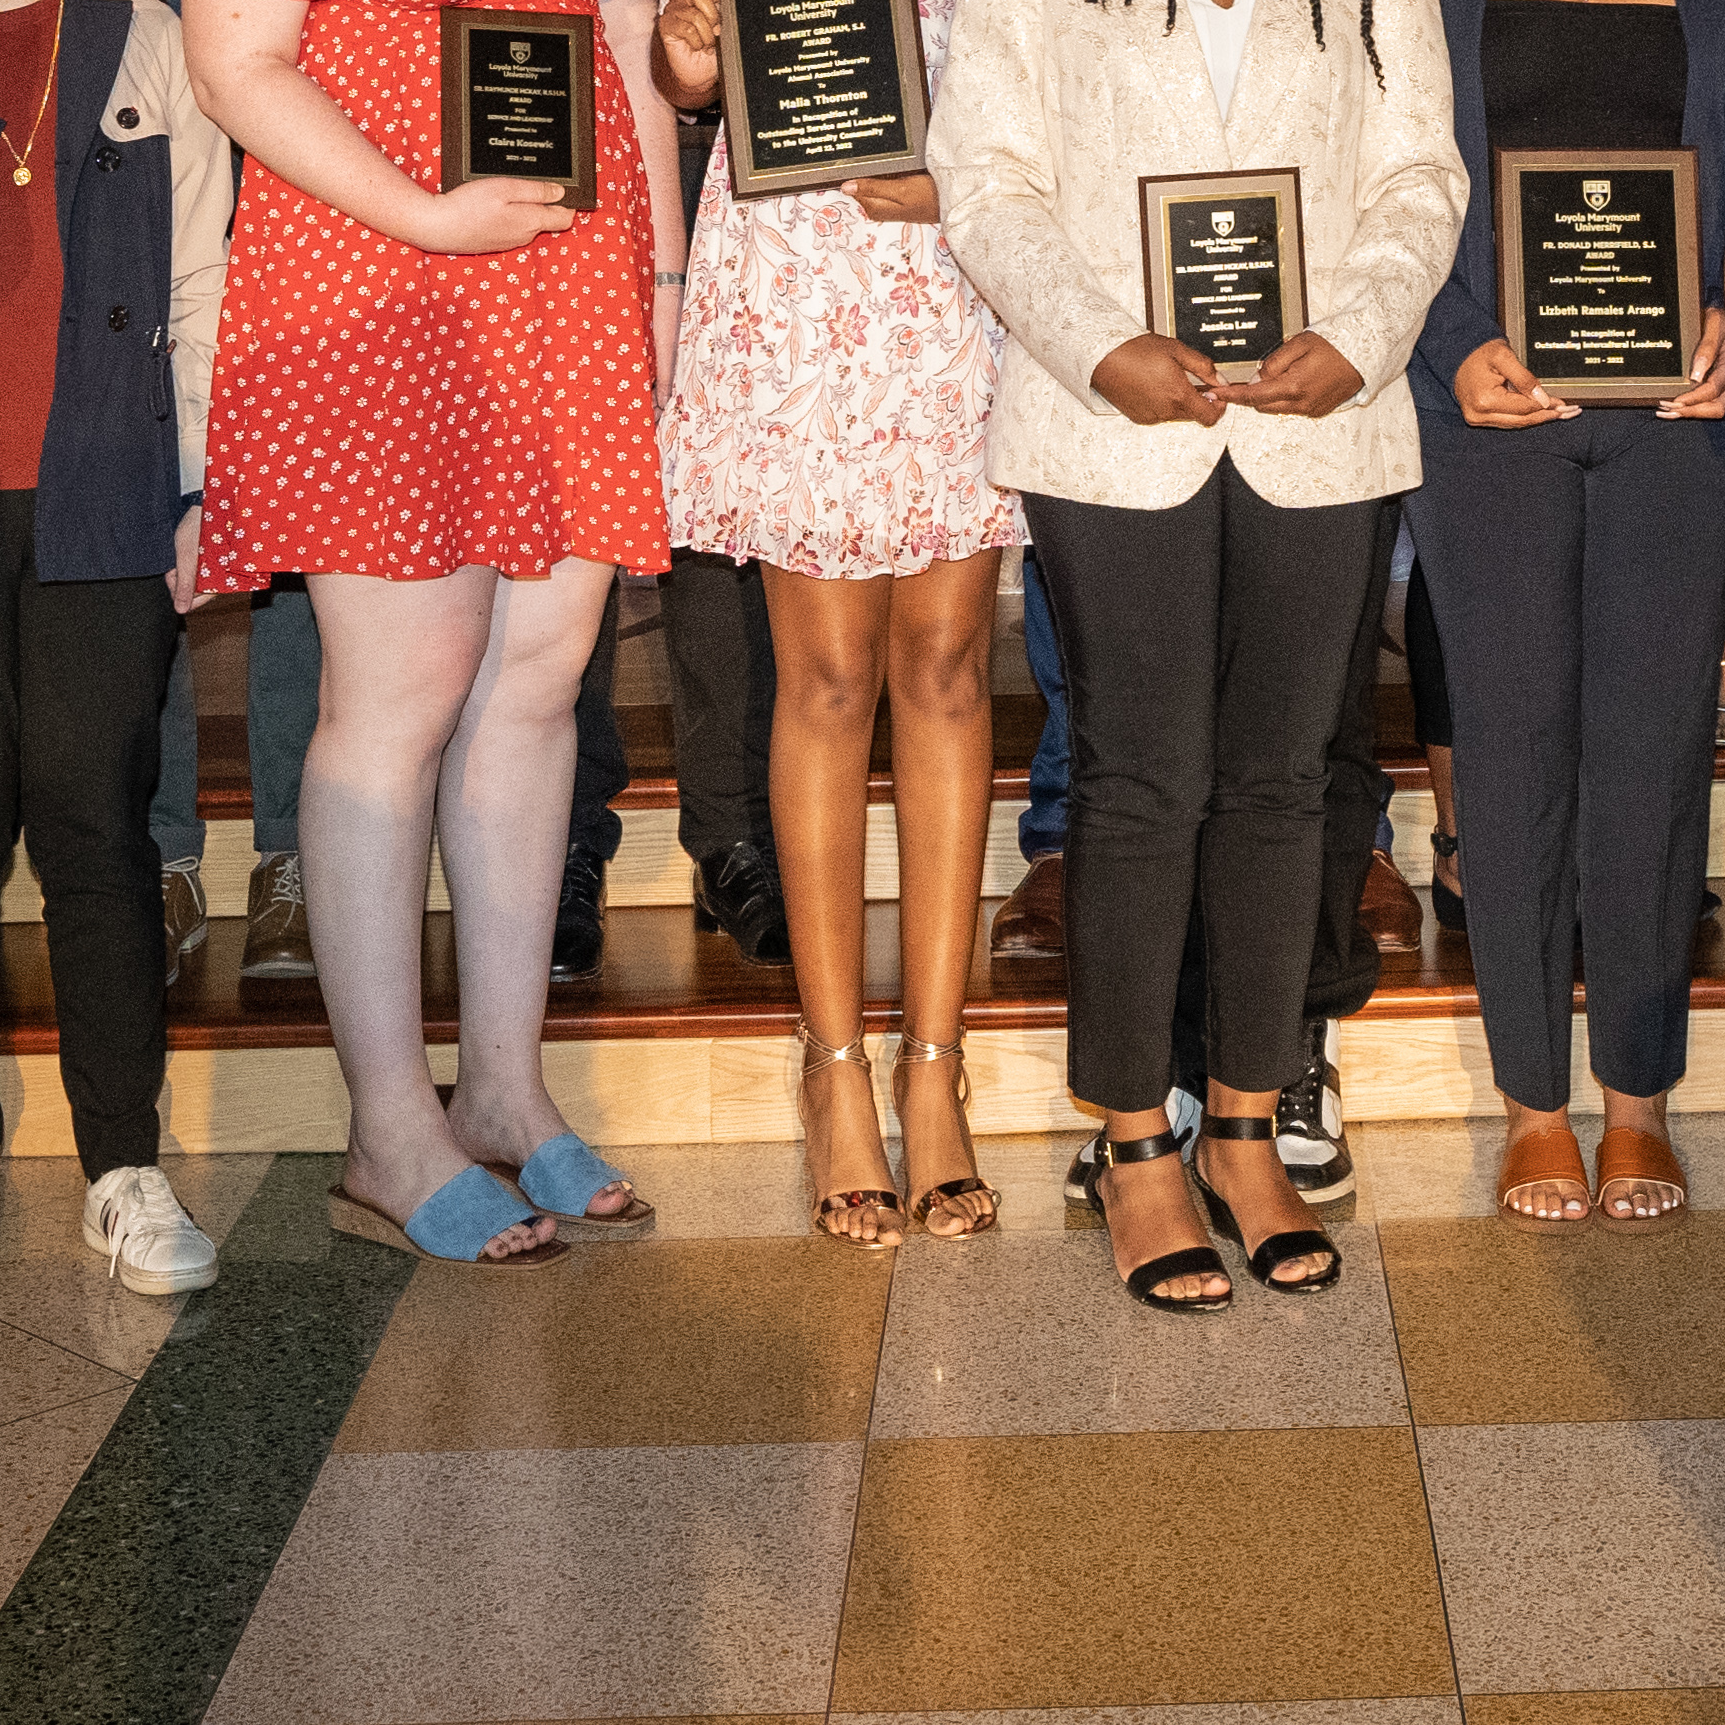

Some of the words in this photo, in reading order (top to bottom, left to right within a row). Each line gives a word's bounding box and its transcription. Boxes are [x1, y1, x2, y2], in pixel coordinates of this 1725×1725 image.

[770, 2, 801, 15] Loyola
[789, 8, 837, 21] University
[779, 29, 812, 40] ROBERT
[779, 96, 811, 110] Malia
[812, 90, 868, 105] Thornton
[488, 137, 515, 146] Claire
[1555, 212, 1586, 223] Loyola
[1587, 213, 1640, 223] Marymount
[1574, 221, 1622, 233] University
[1584, 251, 1615, 259] AWARD
[1539, 305, 1578, 316] Lizbeth
[1581, 304, 1624, 315] Ramales
[1626, 304, 1665, 316] Arango
[1580, 329, 1625, 339] Recognition
[1626, 328, 1636, 337] of
[1534, 341, 1581, 350] Outstanding
[1630, 340, 1673, 349] Leadership
